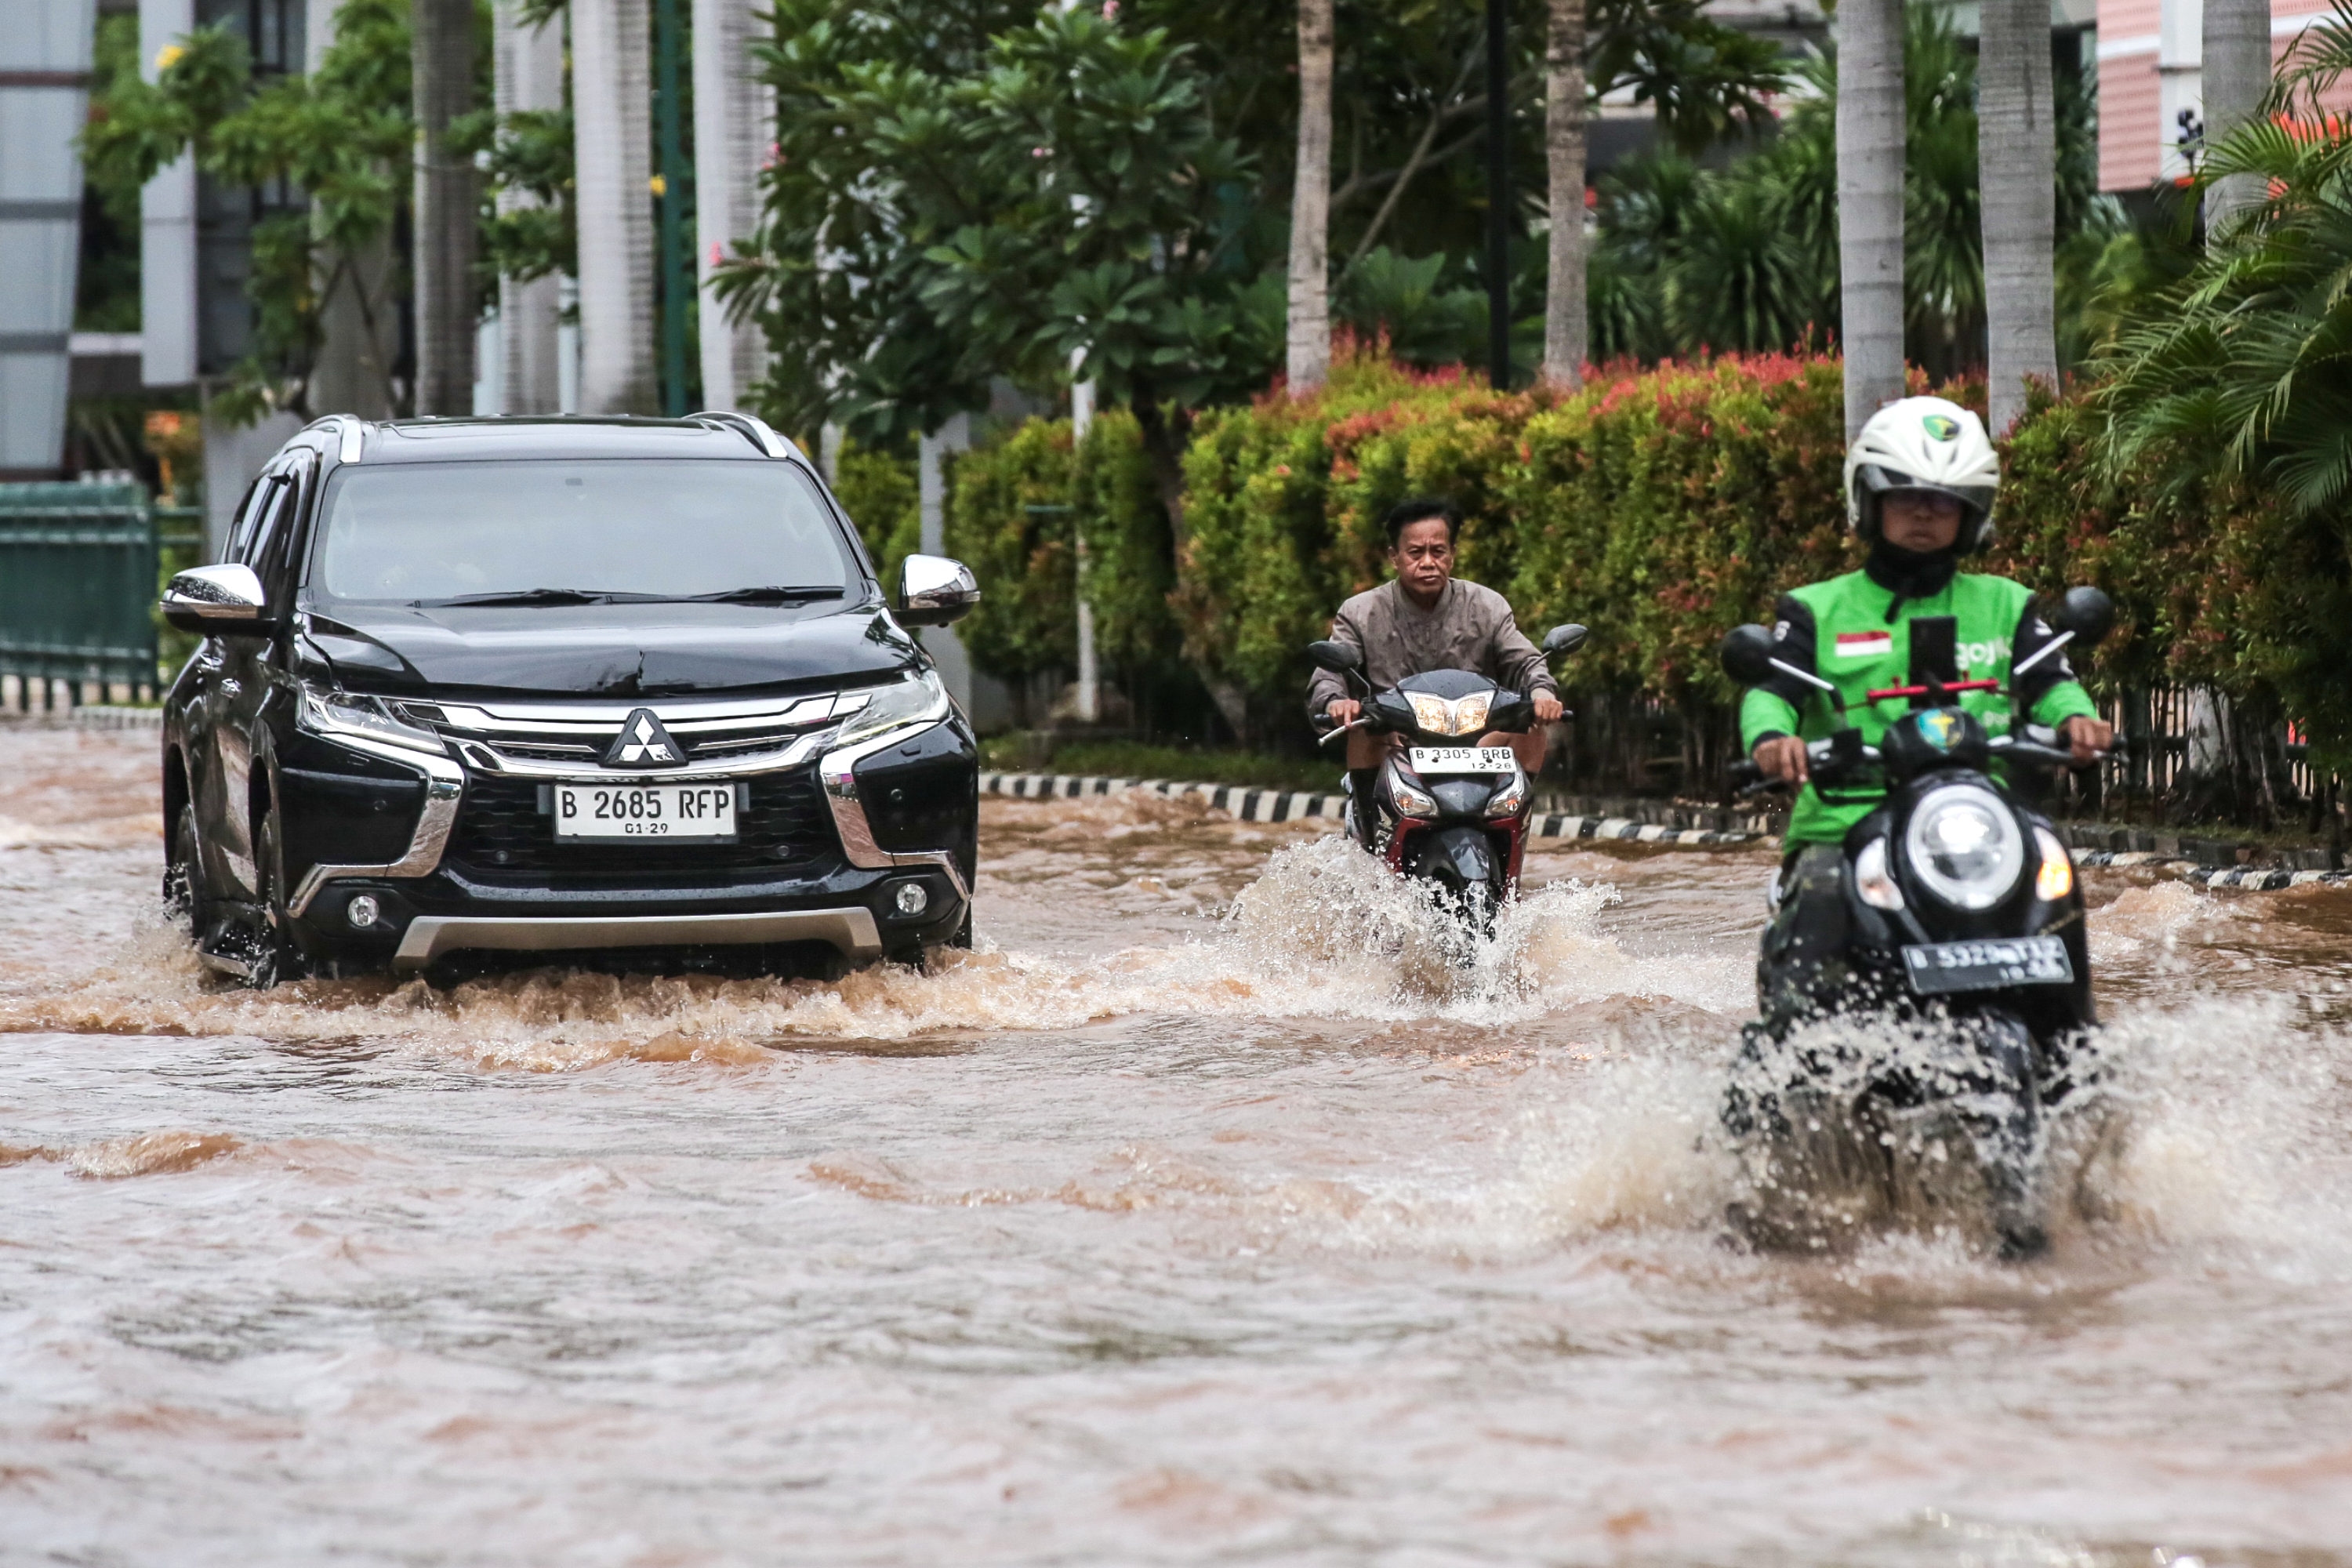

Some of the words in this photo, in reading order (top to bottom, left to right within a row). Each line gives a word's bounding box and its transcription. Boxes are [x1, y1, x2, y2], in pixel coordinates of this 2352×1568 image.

[1416, 750, 1424, 759] B
[1432, 749, 1471, 759] 3305
[1482, 749, 1511, 759] BRB
[562, 791, 577, 818] B
[593, 790, 662, 818] 2685
[679, 790, 729, 818] RFP
